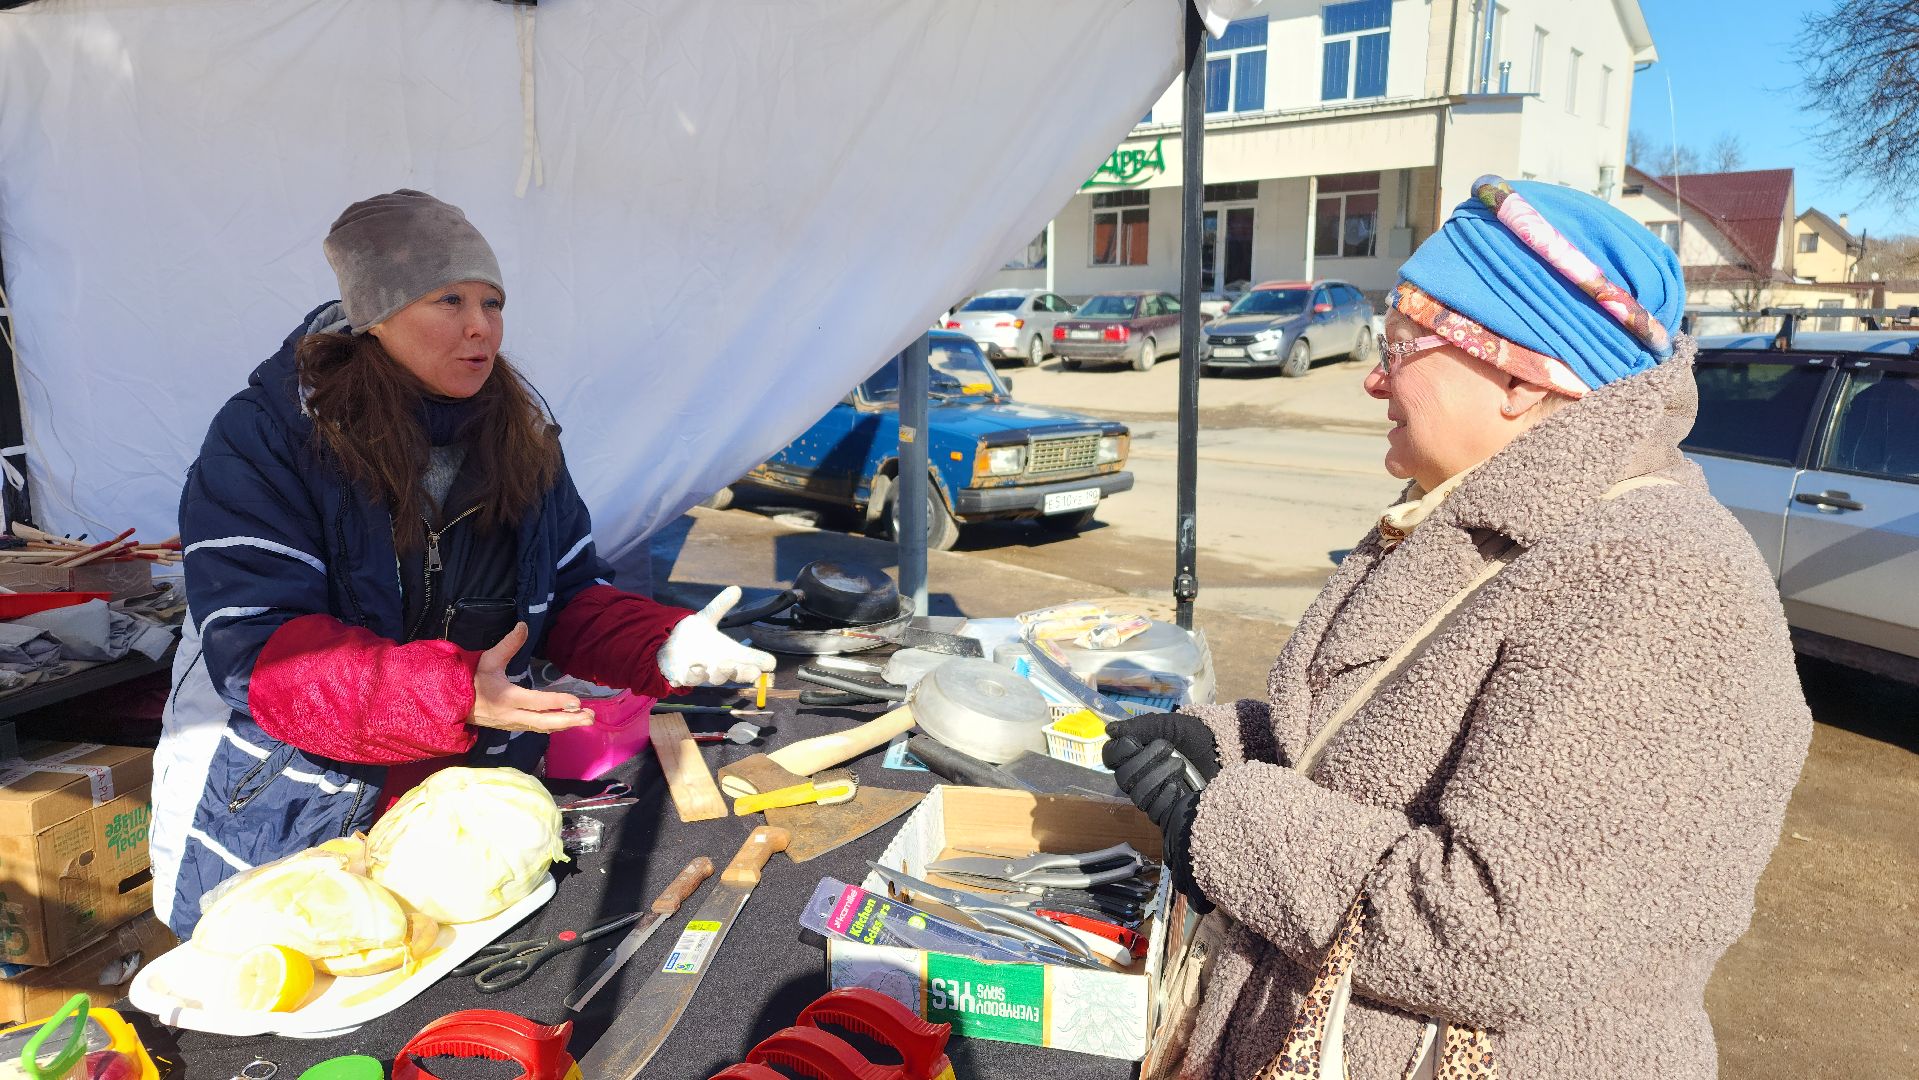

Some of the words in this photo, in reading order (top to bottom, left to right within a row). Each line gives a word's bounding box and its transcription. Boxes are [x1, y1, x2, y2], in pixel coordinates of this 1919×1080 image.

[116, 824, 150, 859] lobal
[838, 888, 858, 922] kamille
[849, 898, 877, 938] Kitchen
[863, 903, 891, 945] Scissrs
[931, 977, 976, 1014] YES
[976, 983, 1006, 1002] SAYS
[975, 999, 1040, 1023] EVERYBODY
